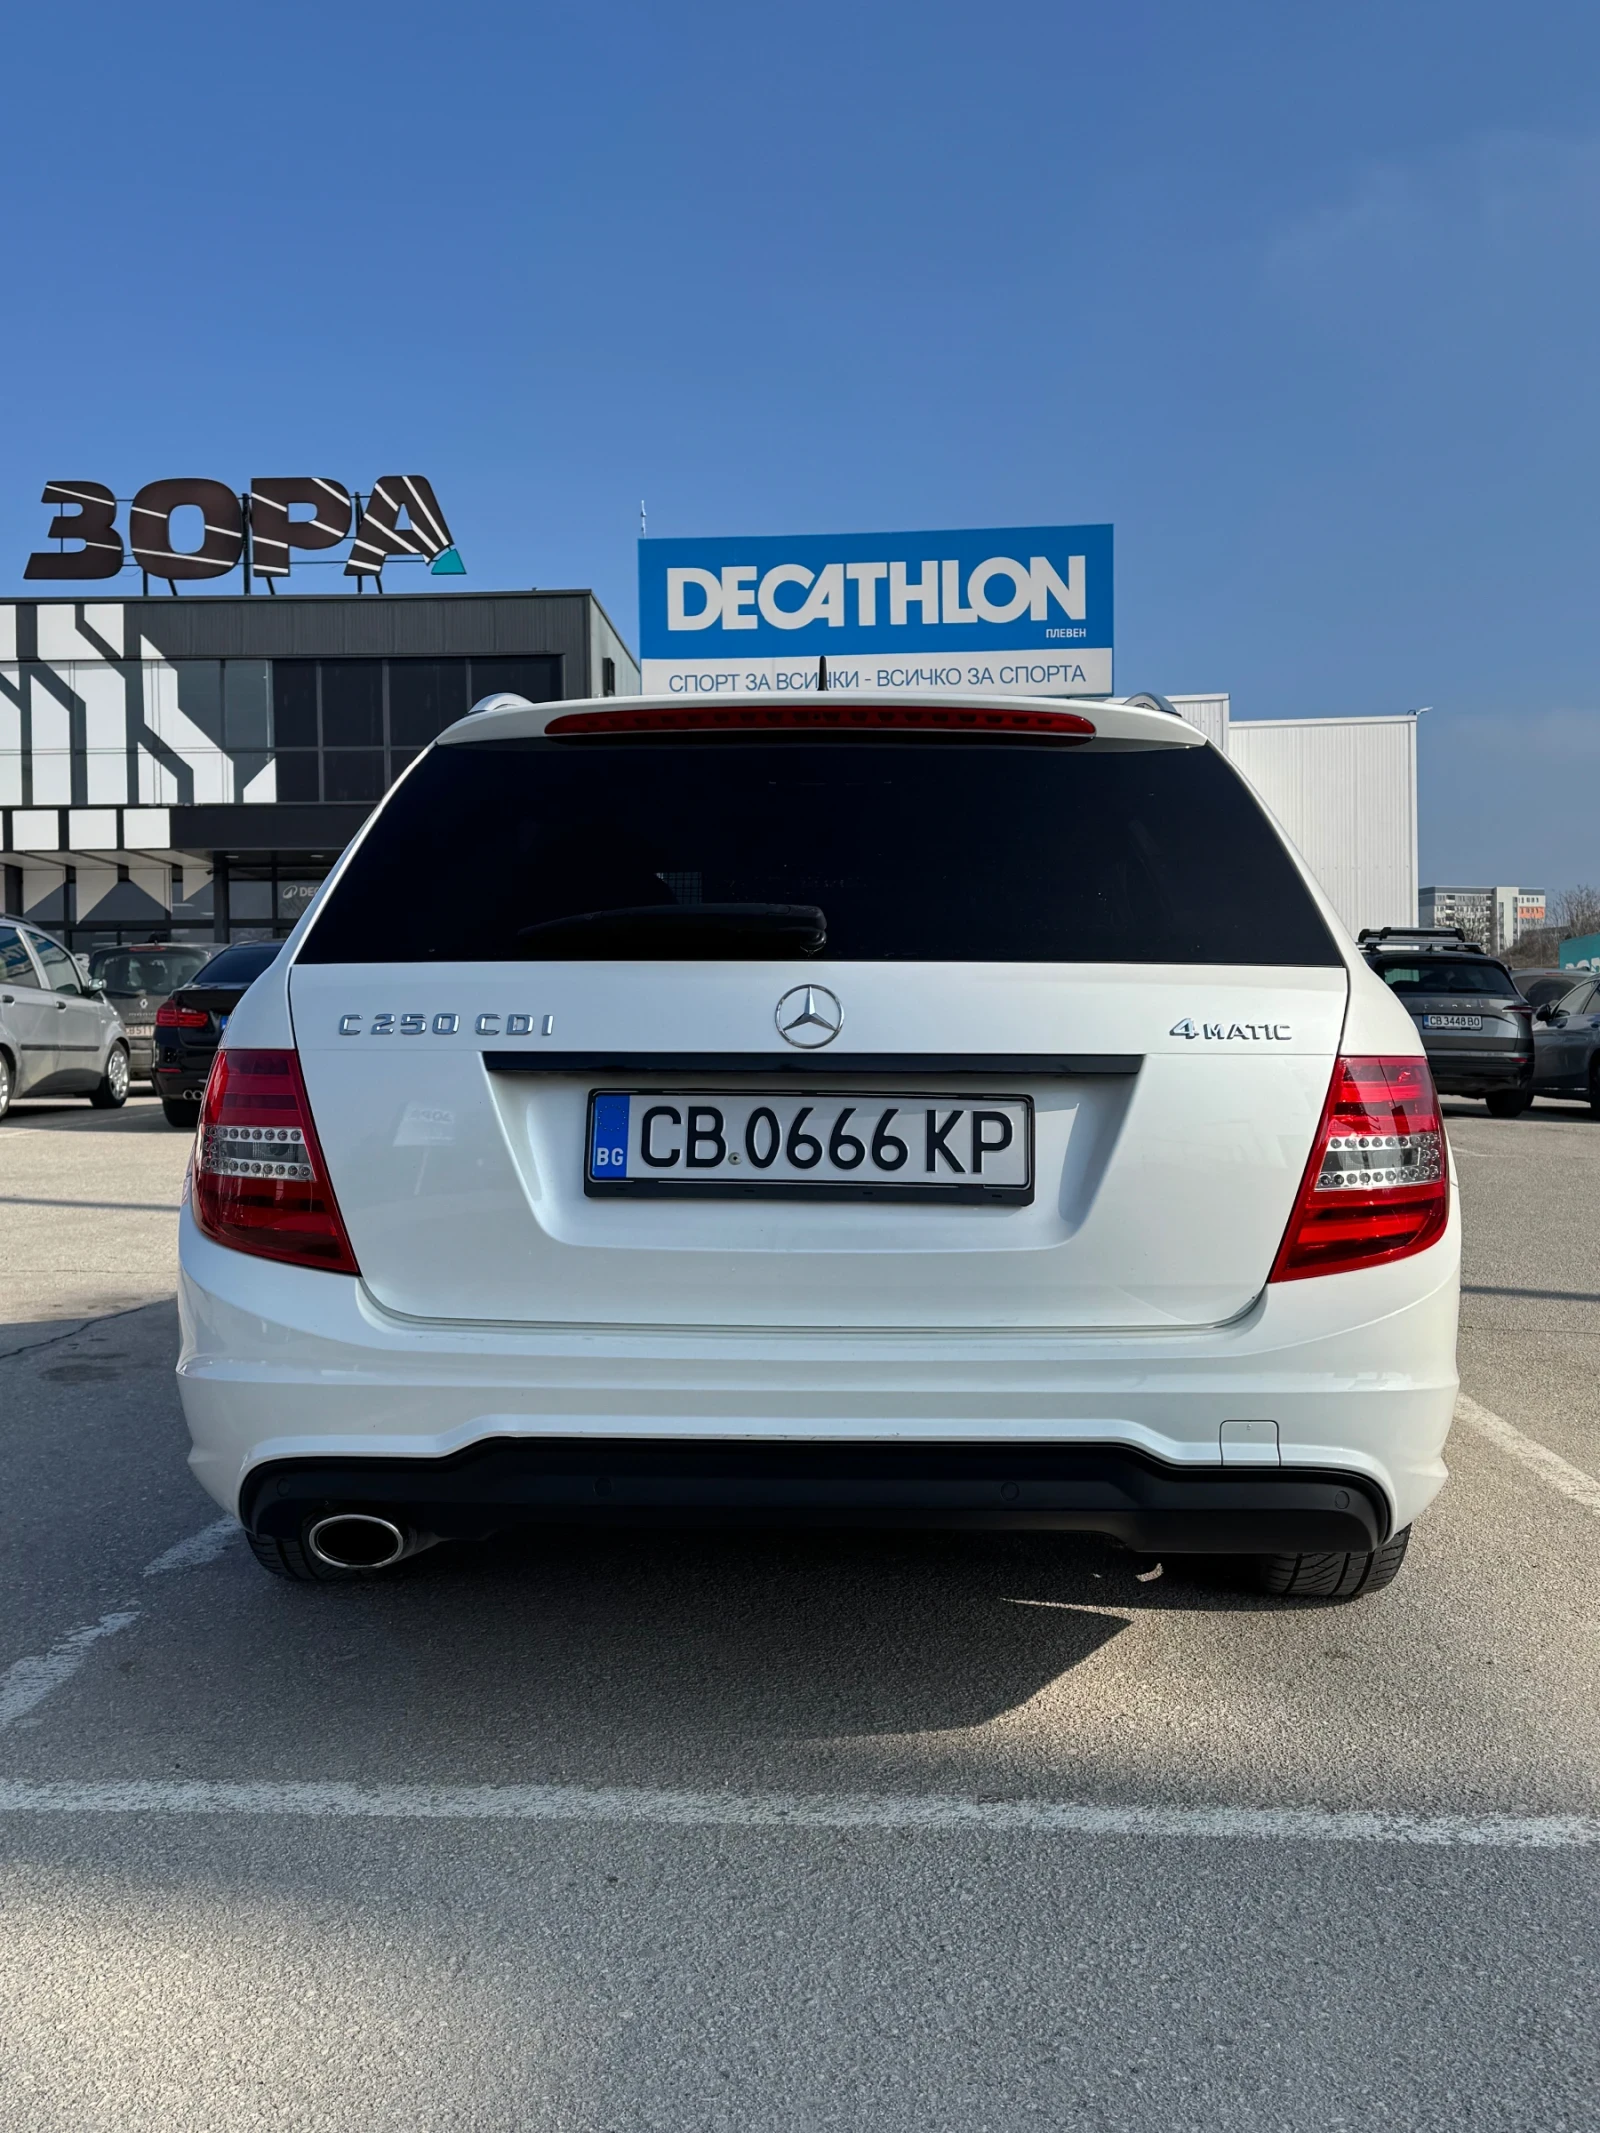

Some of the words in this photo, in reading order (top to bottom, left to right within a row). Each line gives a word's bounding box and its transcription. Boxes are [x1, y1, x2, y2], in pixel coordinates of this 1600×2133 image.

[23, 475, 467, 580] ЗОРА
[666, 555, 1086, 631] DECATHLON
[1045, 628, 1087, 638] ПЛЕВЕН
[669, 674, 740, 692] СПОРТ
[745, 673, 771, 690] ЗА
[877, 668, 962, 687] ВСИЧКО
[967, 667, 995, 685] ЗА
[1000, 665, 1086, 684] СПОРТА
[339, 1014, 363, 1036] C
[370, 1013, 461, 1036] 250
[475, 1013, 554, 1036] CDI
[1429, 1016, 1442, 1026] CB
[1443, 1016, 1466, 1026] 3448
[641, 1106, 727, 1168] CB
[745, 1107, 909, 1171] 0666
[926, 1109, 1014, 1174] KP
[596, 1147, 624, 1167] BG
